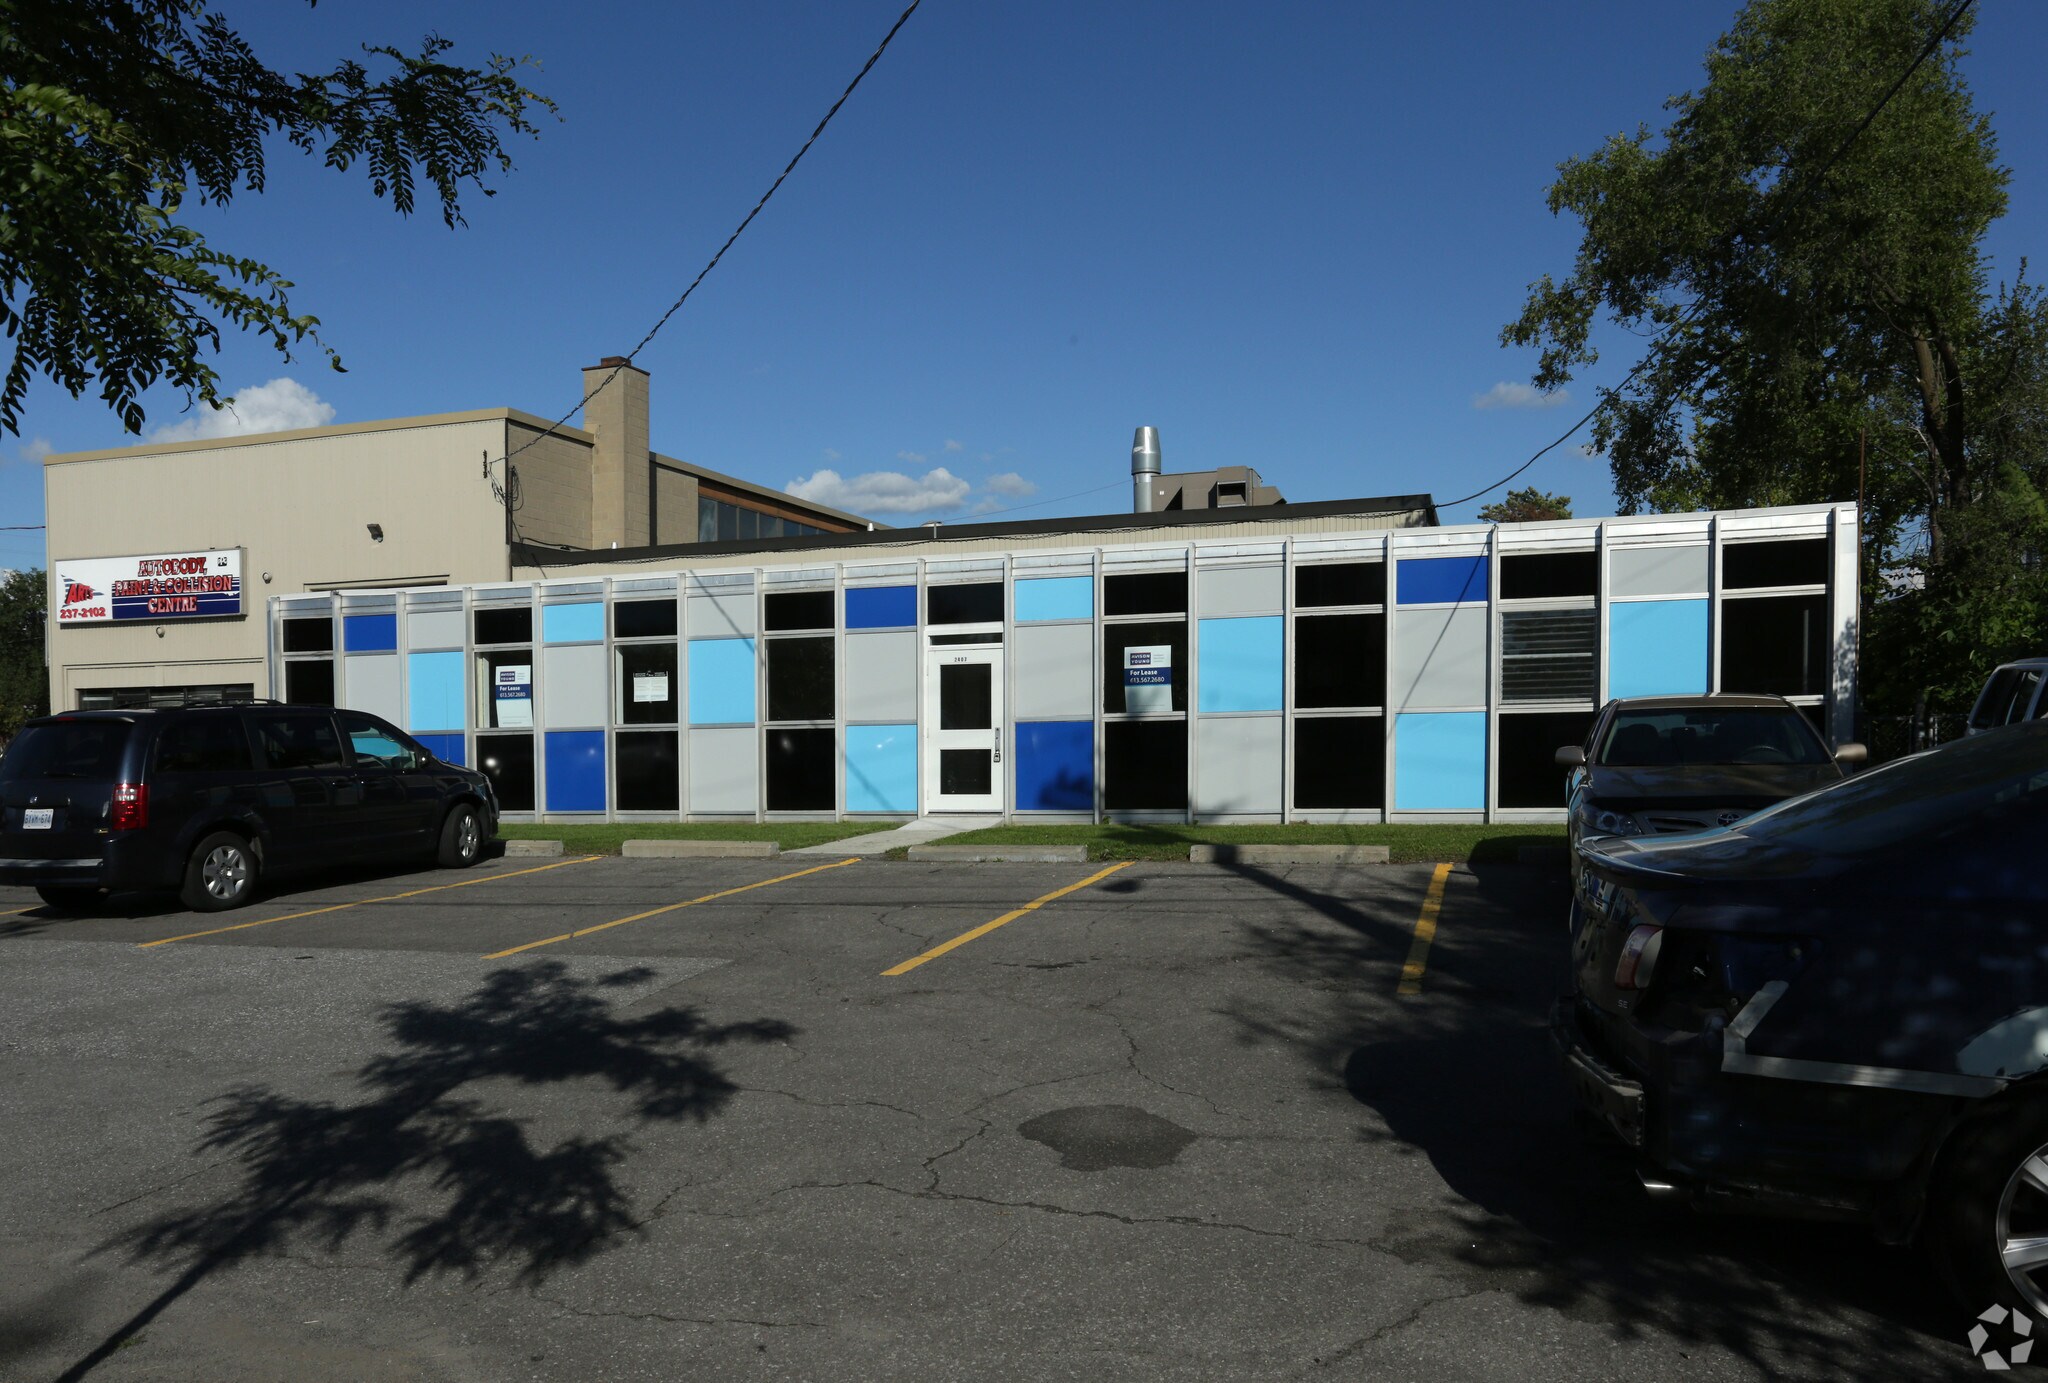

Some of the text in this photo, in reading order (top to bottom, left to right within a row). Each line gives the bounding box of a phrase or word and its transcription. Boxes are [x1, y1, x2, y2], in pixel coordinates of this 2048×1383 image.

[138, 557, 207, 577] AUTOBODY,
[114, 574, 233, 596] PAINT & COLLISION
[59, 607, 106, 619] 237-2102
[147, 596, 197, 613] CENTRE
